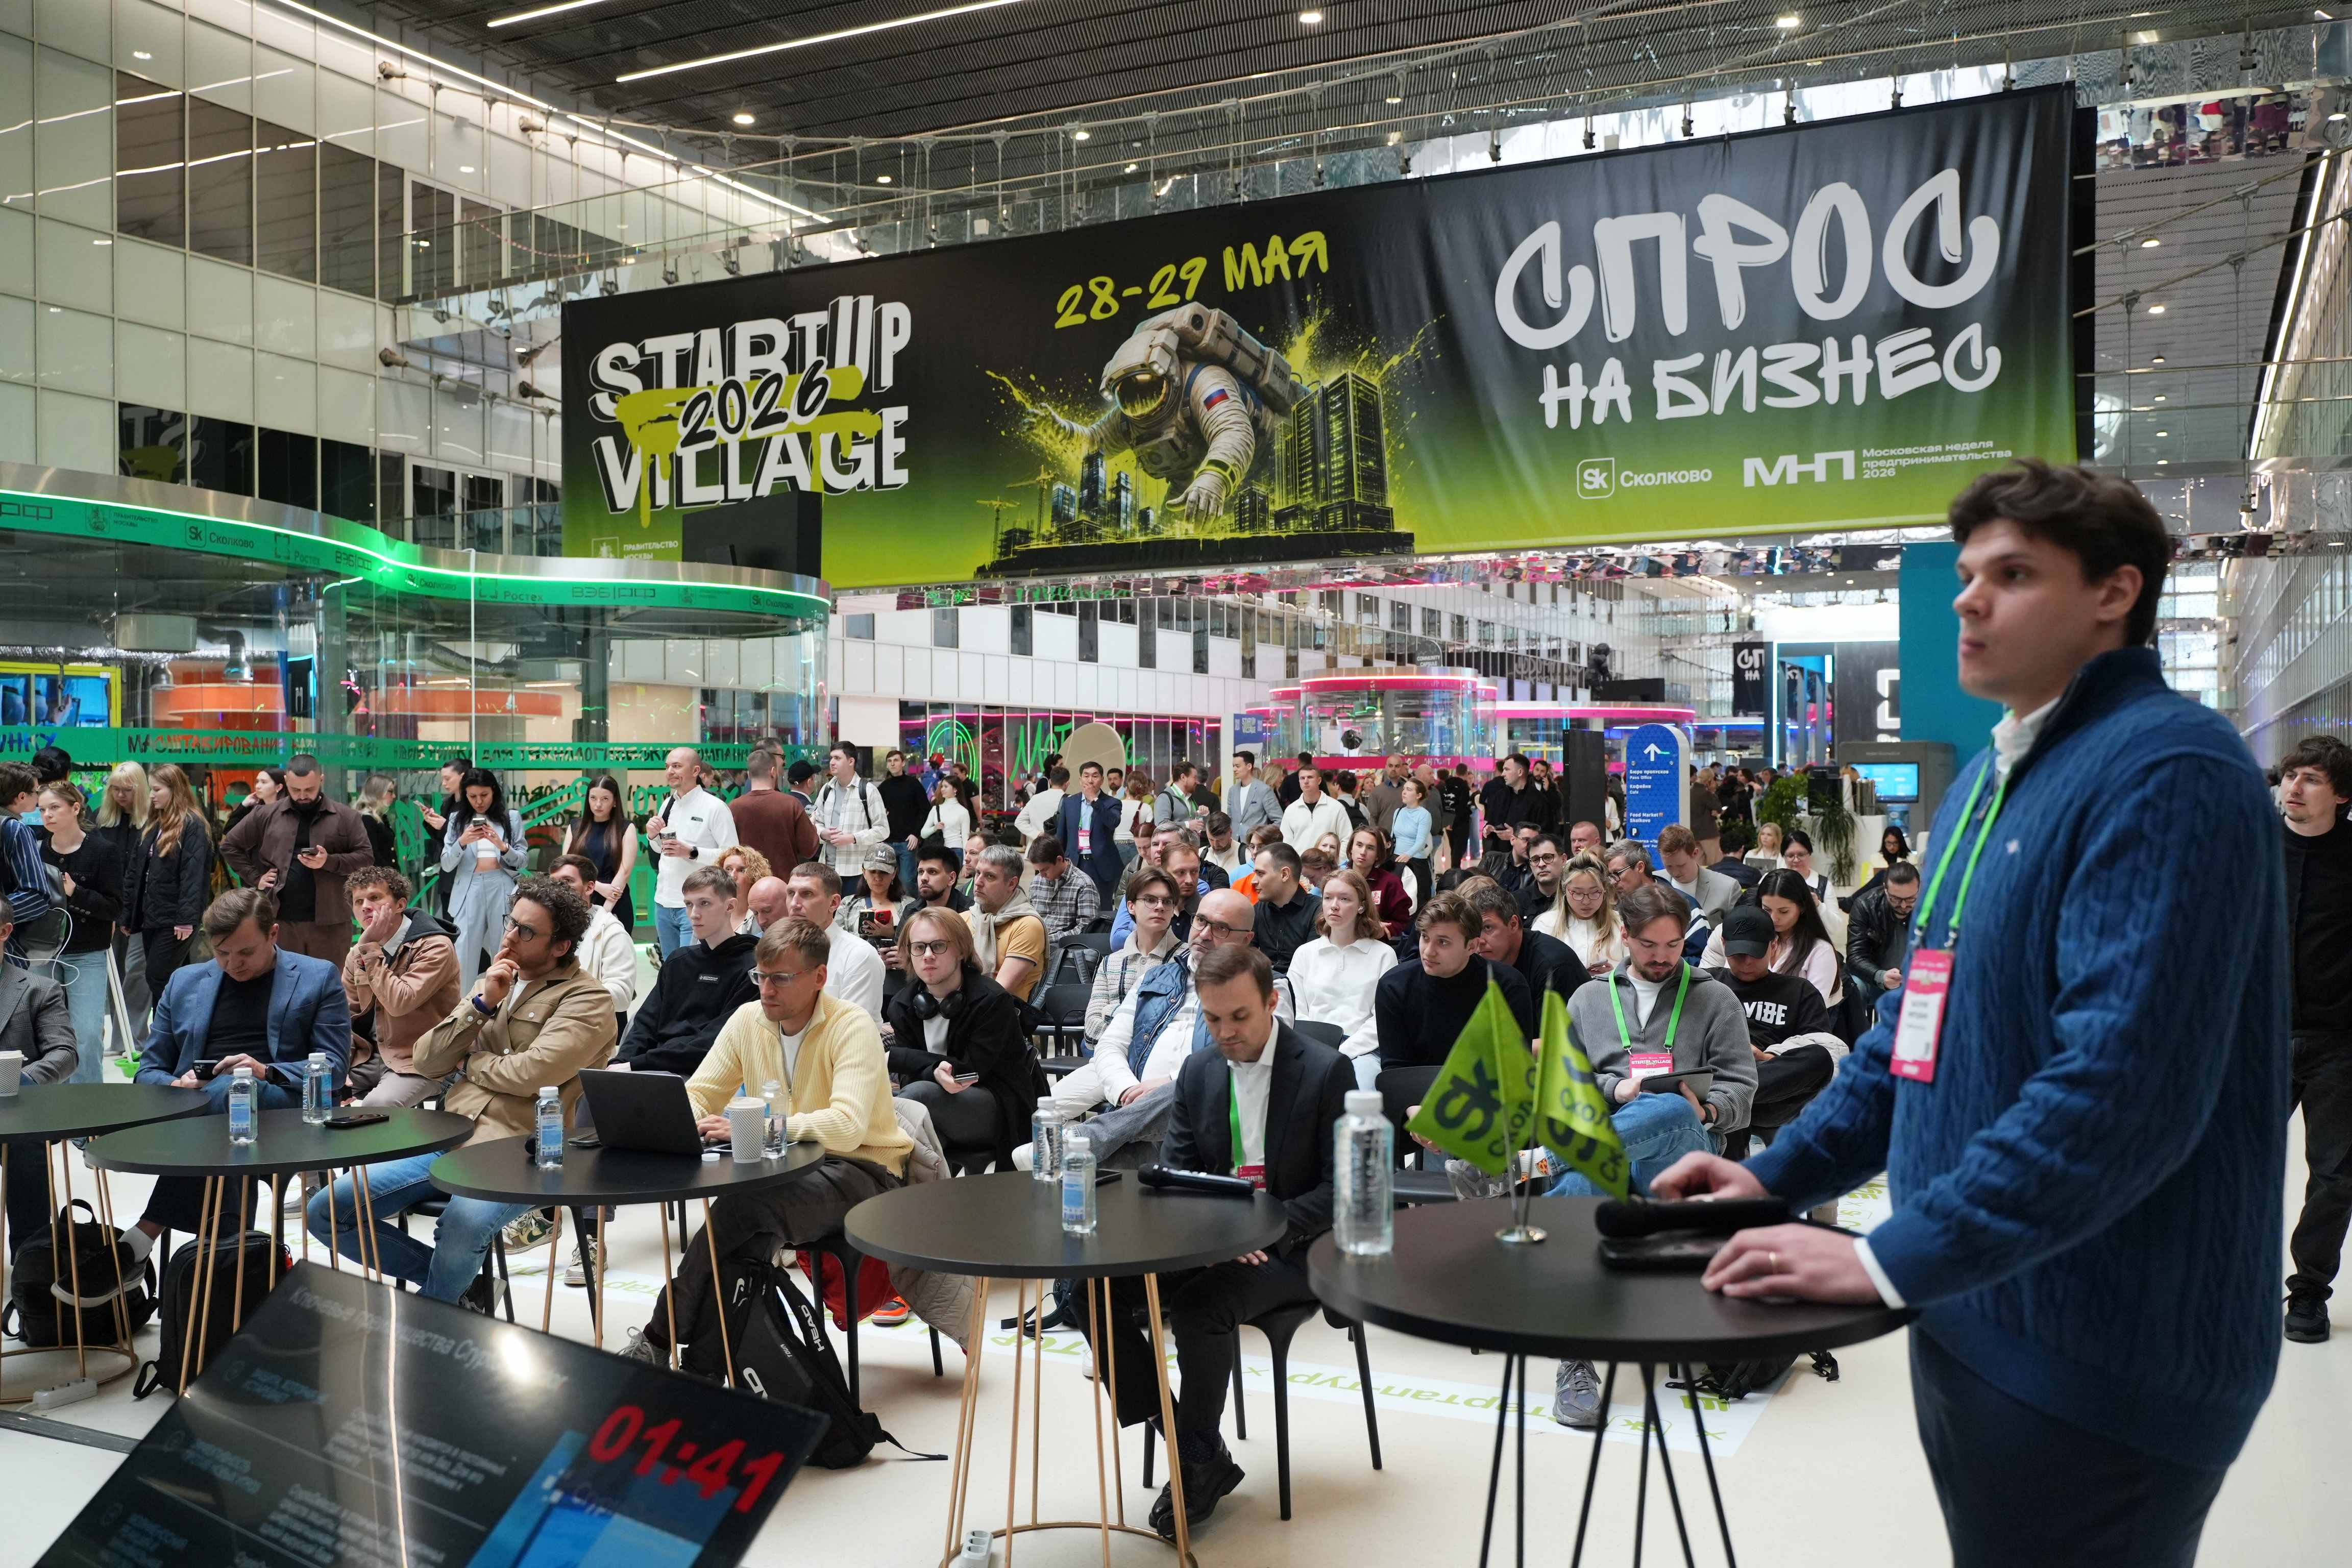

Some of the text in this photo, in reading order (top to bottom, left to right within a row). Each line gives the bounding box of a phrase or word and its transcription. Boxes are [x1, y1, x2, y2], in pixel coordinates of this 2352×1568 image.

[1495, 168, 2000, 350] СПРОС
[1055, 231, 1329, 329] 28-29 МАЯ
[589, 295, 911, 423] STARTUP
[1538, 322, 2002, 429] НА БИЗНЕС
[677, 356, 832, 456] 2026
[1863, 440, 1993, 458] Московская неделя
[592, 406, 909, 514] VILLAGE
[1744, 450, 1855, 487] МНП
[1863, 450, 2012, 470] предпринимательства
[1583, 468, 1608, 489] Sk
[1620, 469, 1712, 487] Сколково
[1863, 468, 1896, 479] 2026
[188, 526, 203, 541] Sk
[209, 532, 254, 548] Сколково
[623, 540, 678, 551] ПРАВИТЕЛЬСТВО
[420, 578, 457, 591] Сколково
[504, 592, 544, 602] Ростех
[751, 594, 762, 606] Sk
[766, 599, 794, 609] Сколково
[1744, 669, 1760, 681] НА
[481, 747, 513, 762] ДЛЯ
[800, 1304, 825, 1352] HEAD
[589, 1404, 785, 1514] 01:41
